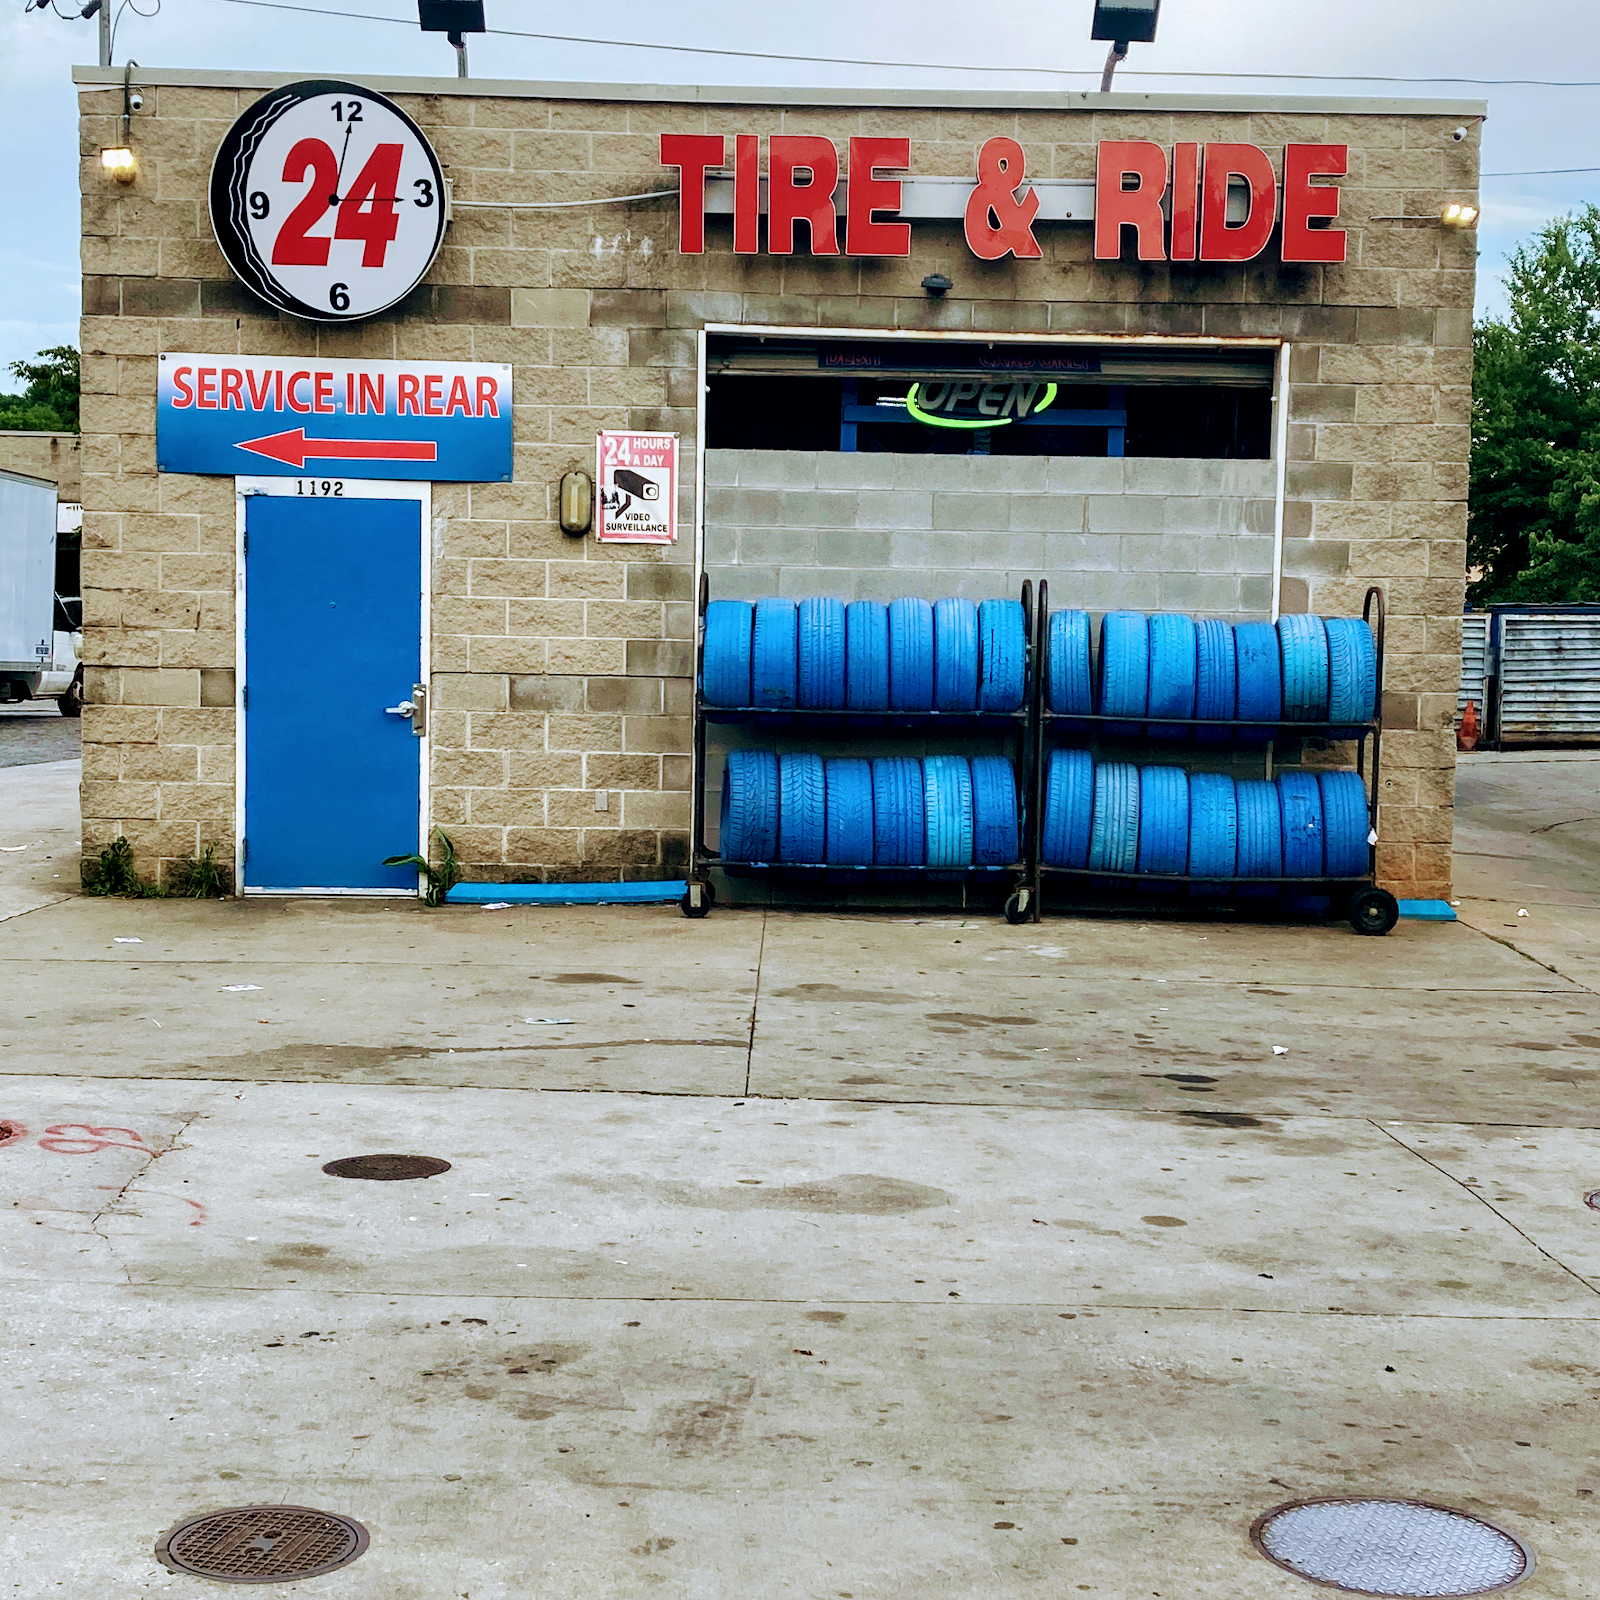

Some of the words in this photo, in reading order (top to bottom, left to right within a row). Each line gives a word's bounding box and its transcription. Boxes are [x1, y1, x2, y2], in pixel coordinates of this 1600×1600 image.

[331, 101, 363, 122] 12
[249, 191, 270, 220] 9
[271, 137, 404, 268] 24
[413, 178, 434, 208] 3
[660, 133, 911, 257] TIRE
[964, 135, 1044, 260] &
[1094, 140, 1349, 263] RIDE
[329, 282, 351, 311] 6
[172, 366, 335, 414] SERVICE
[345, 372, 385, 415] IN
[396, 374, 501, 418] REAR
[917, 382, 1039, 418] OPEN
[604, 436, 631, 466] 24
[633, 438, 672, 450] HOURS
[632, 455, 641, 466] A
[643, 455, 665, 467] DAY
[297, 480, 344, 497] 1192
[605, 523, 668, 532] SURVEILLANCE
[625, 513, 650, 521] VIDEO
